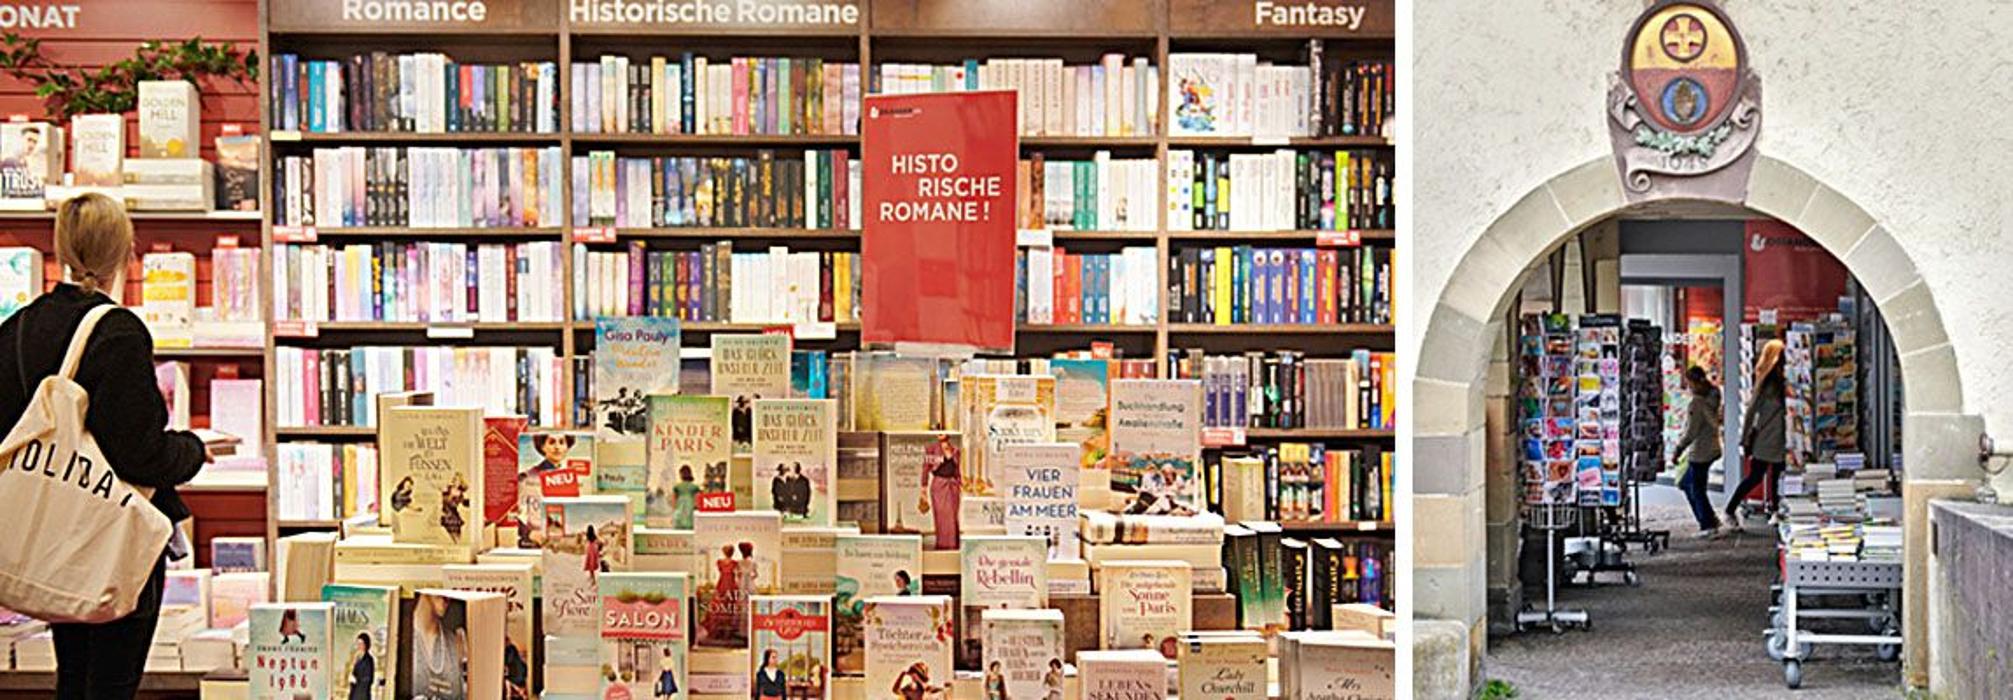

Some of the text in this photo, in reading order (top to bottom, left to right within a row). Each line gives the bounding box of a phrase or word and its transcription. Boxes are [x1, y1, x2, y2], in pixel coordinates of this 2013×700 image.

[343, 0, 487, 21] Romance
[570, 0, 858, 25] Historische Romane
[1255, 2, 1365, 30] Fantasy
[891, 153, 959, 174] HISTO
[918, 176, 1001, 197] RISCHE
[880, 200, 990, 221] ROMANE !
[636, 328, 668, 345] Pauly
[655, 424, 722, 437] KINDER
[545, 472, 574, 487] NEU
[1026, 468, 1061, 482] VIER
[1013, 485, 1074, 499] FRAUEN
[703, 496, 732, 509] NEU
[1009, 503, 1078, 518] AM MEER
[1129, 588, 1170, 601] Sonne
[606, 609, 676, 628] SALON
[256, 655, 319, 672] Neptun
